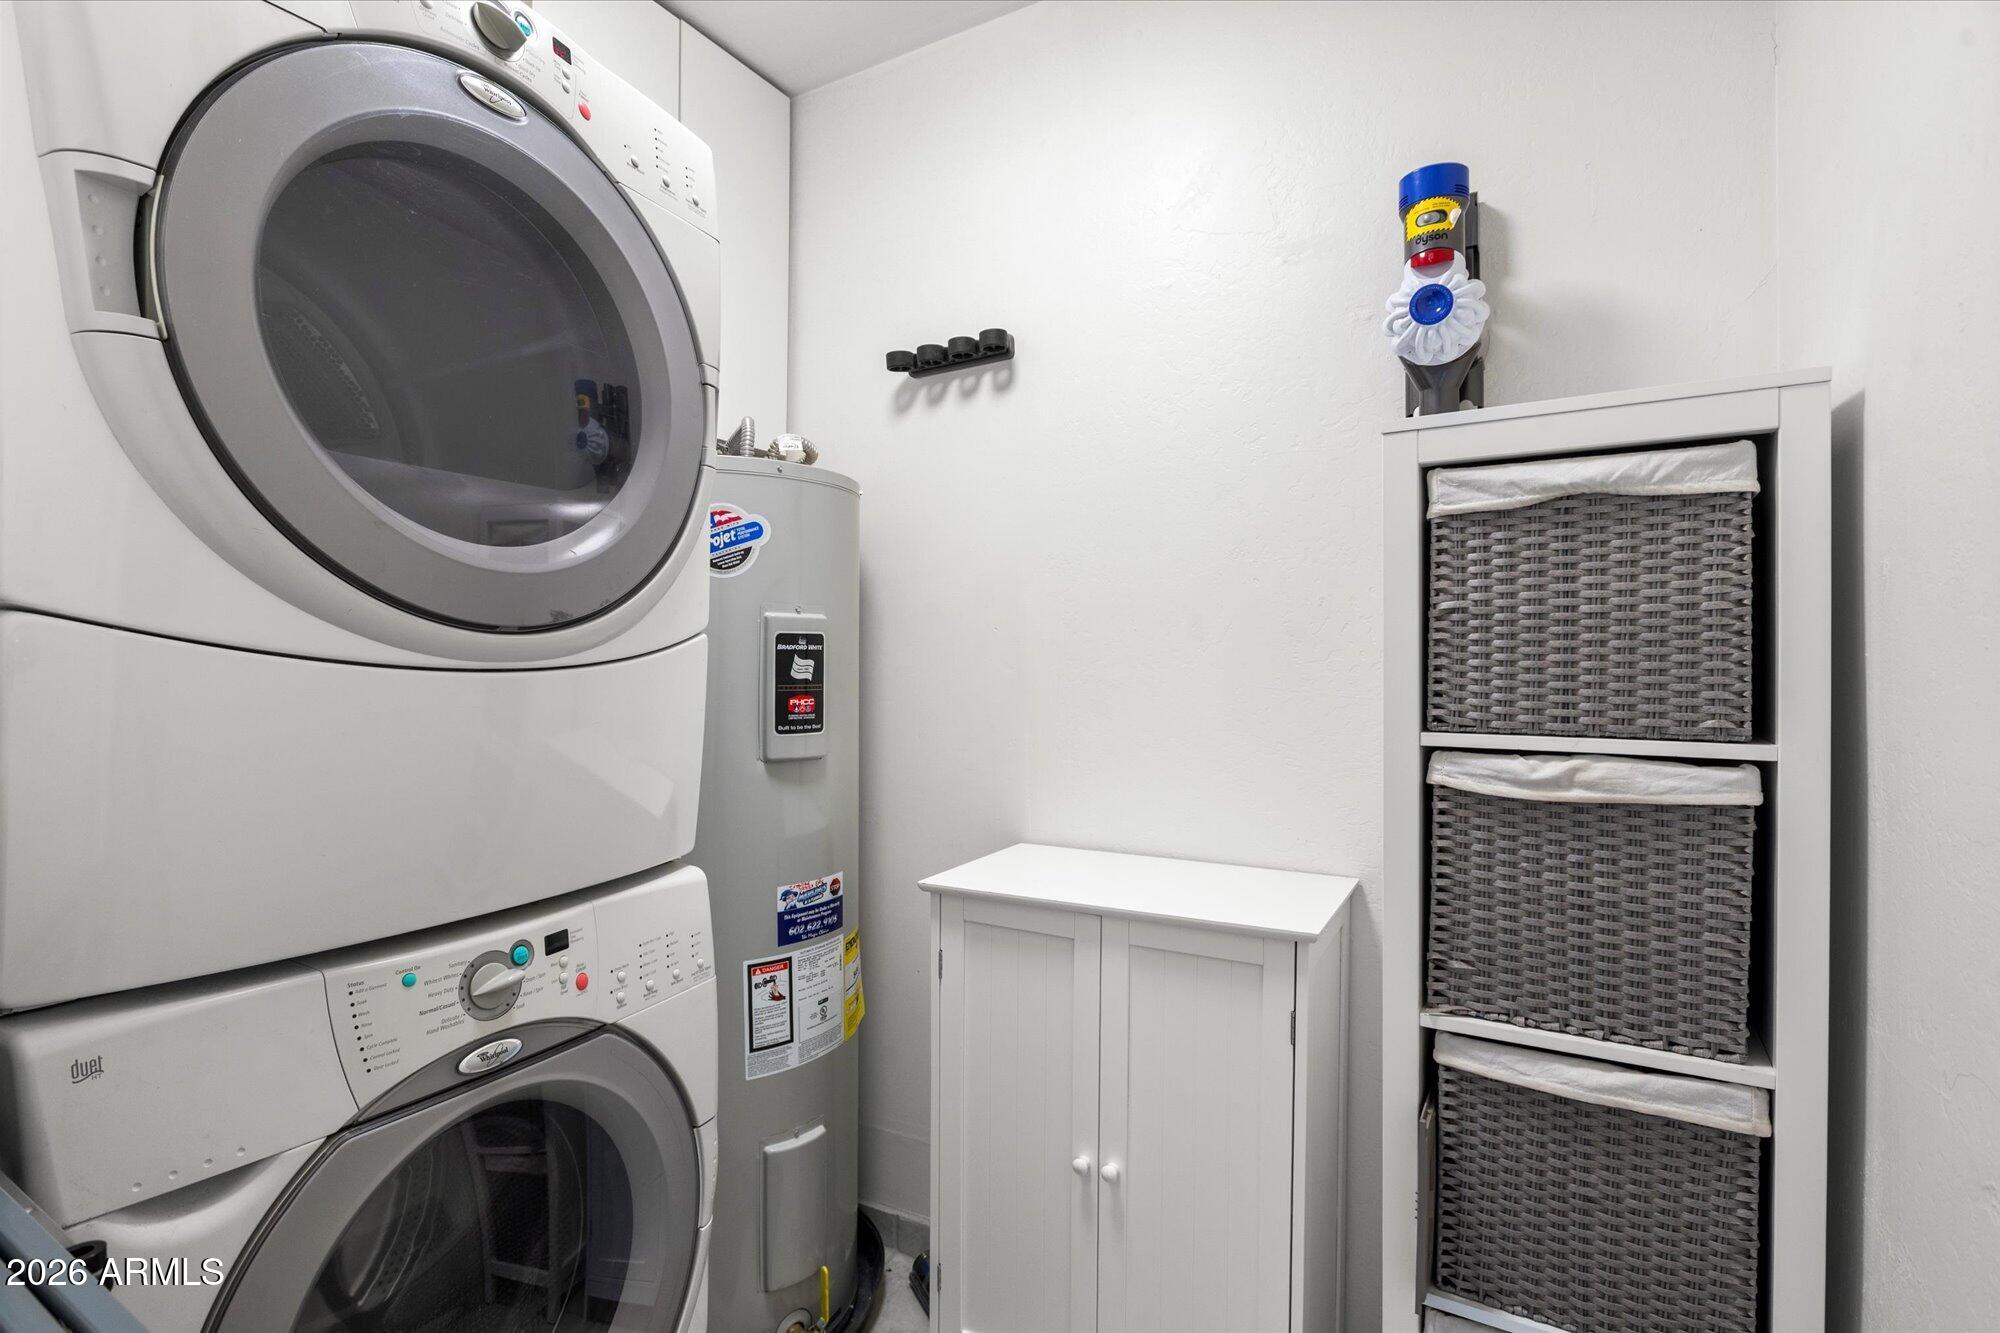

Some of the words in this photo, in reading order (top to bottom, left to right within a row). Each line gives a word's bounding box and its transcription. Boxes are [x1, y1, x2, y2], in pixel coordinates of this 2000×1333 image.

[1415, 232, 1448, 246] dyson
[789, 698, 815, 706] PHCC
[448, 960, 467, 969] Sanitary
[761, 964, 785, 973] DANGER
[395, 966, 413, 976] Control
[347, 980, 365, 988] Status
[423, 976, 443, 986] Whitest
[443, 972, 460, 982] Whites
[428, 989, 444, 999] Heavy
[445, 986, 455, 996] Duty
[419, 1001, 456, 1017] Normal/Casual
[441, 1014, 460, 1025] Delicate
[426, 1026, 440, 1036] Hand
[440, 1020, 465, 1031] Washables
[366, 1042, 378, 1050] Cycle
[369, 1050, 386, 1060] Control
[71, 1055, 104, 1080] duet
[373, 1063, 385, 1071] Door
